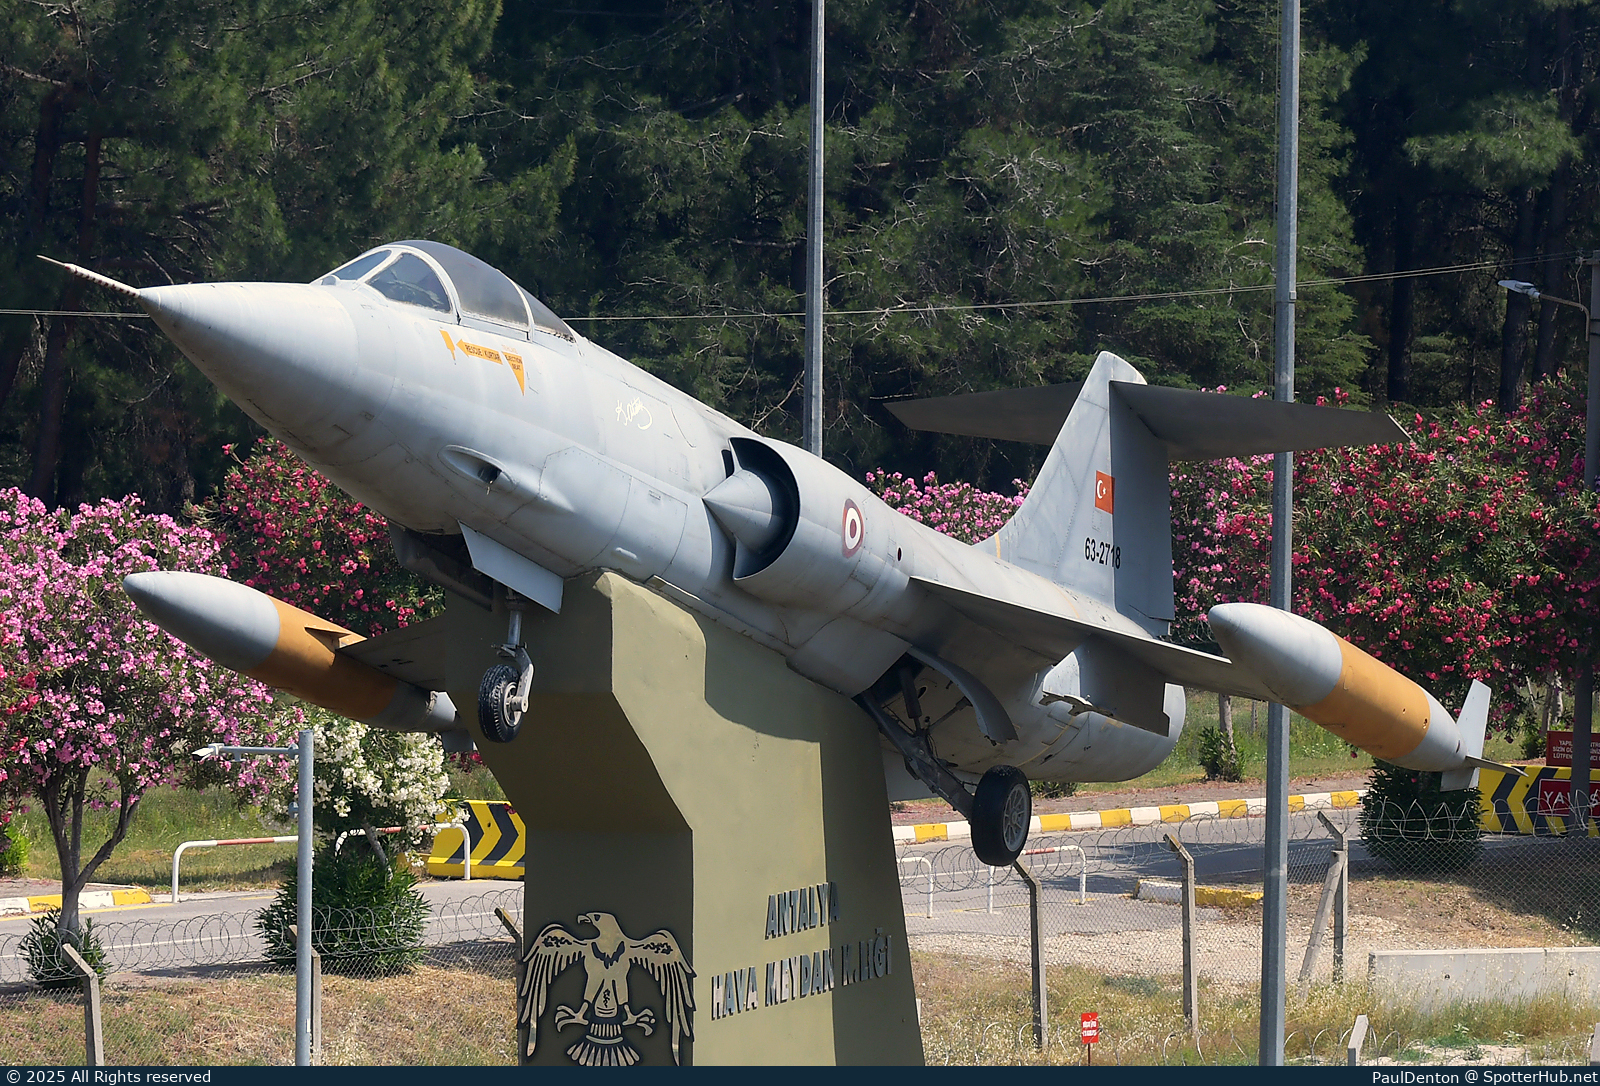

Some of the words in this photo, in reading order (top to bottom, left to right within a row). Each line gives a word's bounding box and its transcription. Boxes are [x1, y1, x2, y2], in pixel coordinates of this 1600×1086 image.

[465, 344, 483, 357] RESCUE
[1084, 537, 1121, 569] 63-2718
[764, 882, 840, 940] ANTALYA
[711, 965, 759, 1021] HAVA
[764, 948, 835, 1007] MEYDAN
